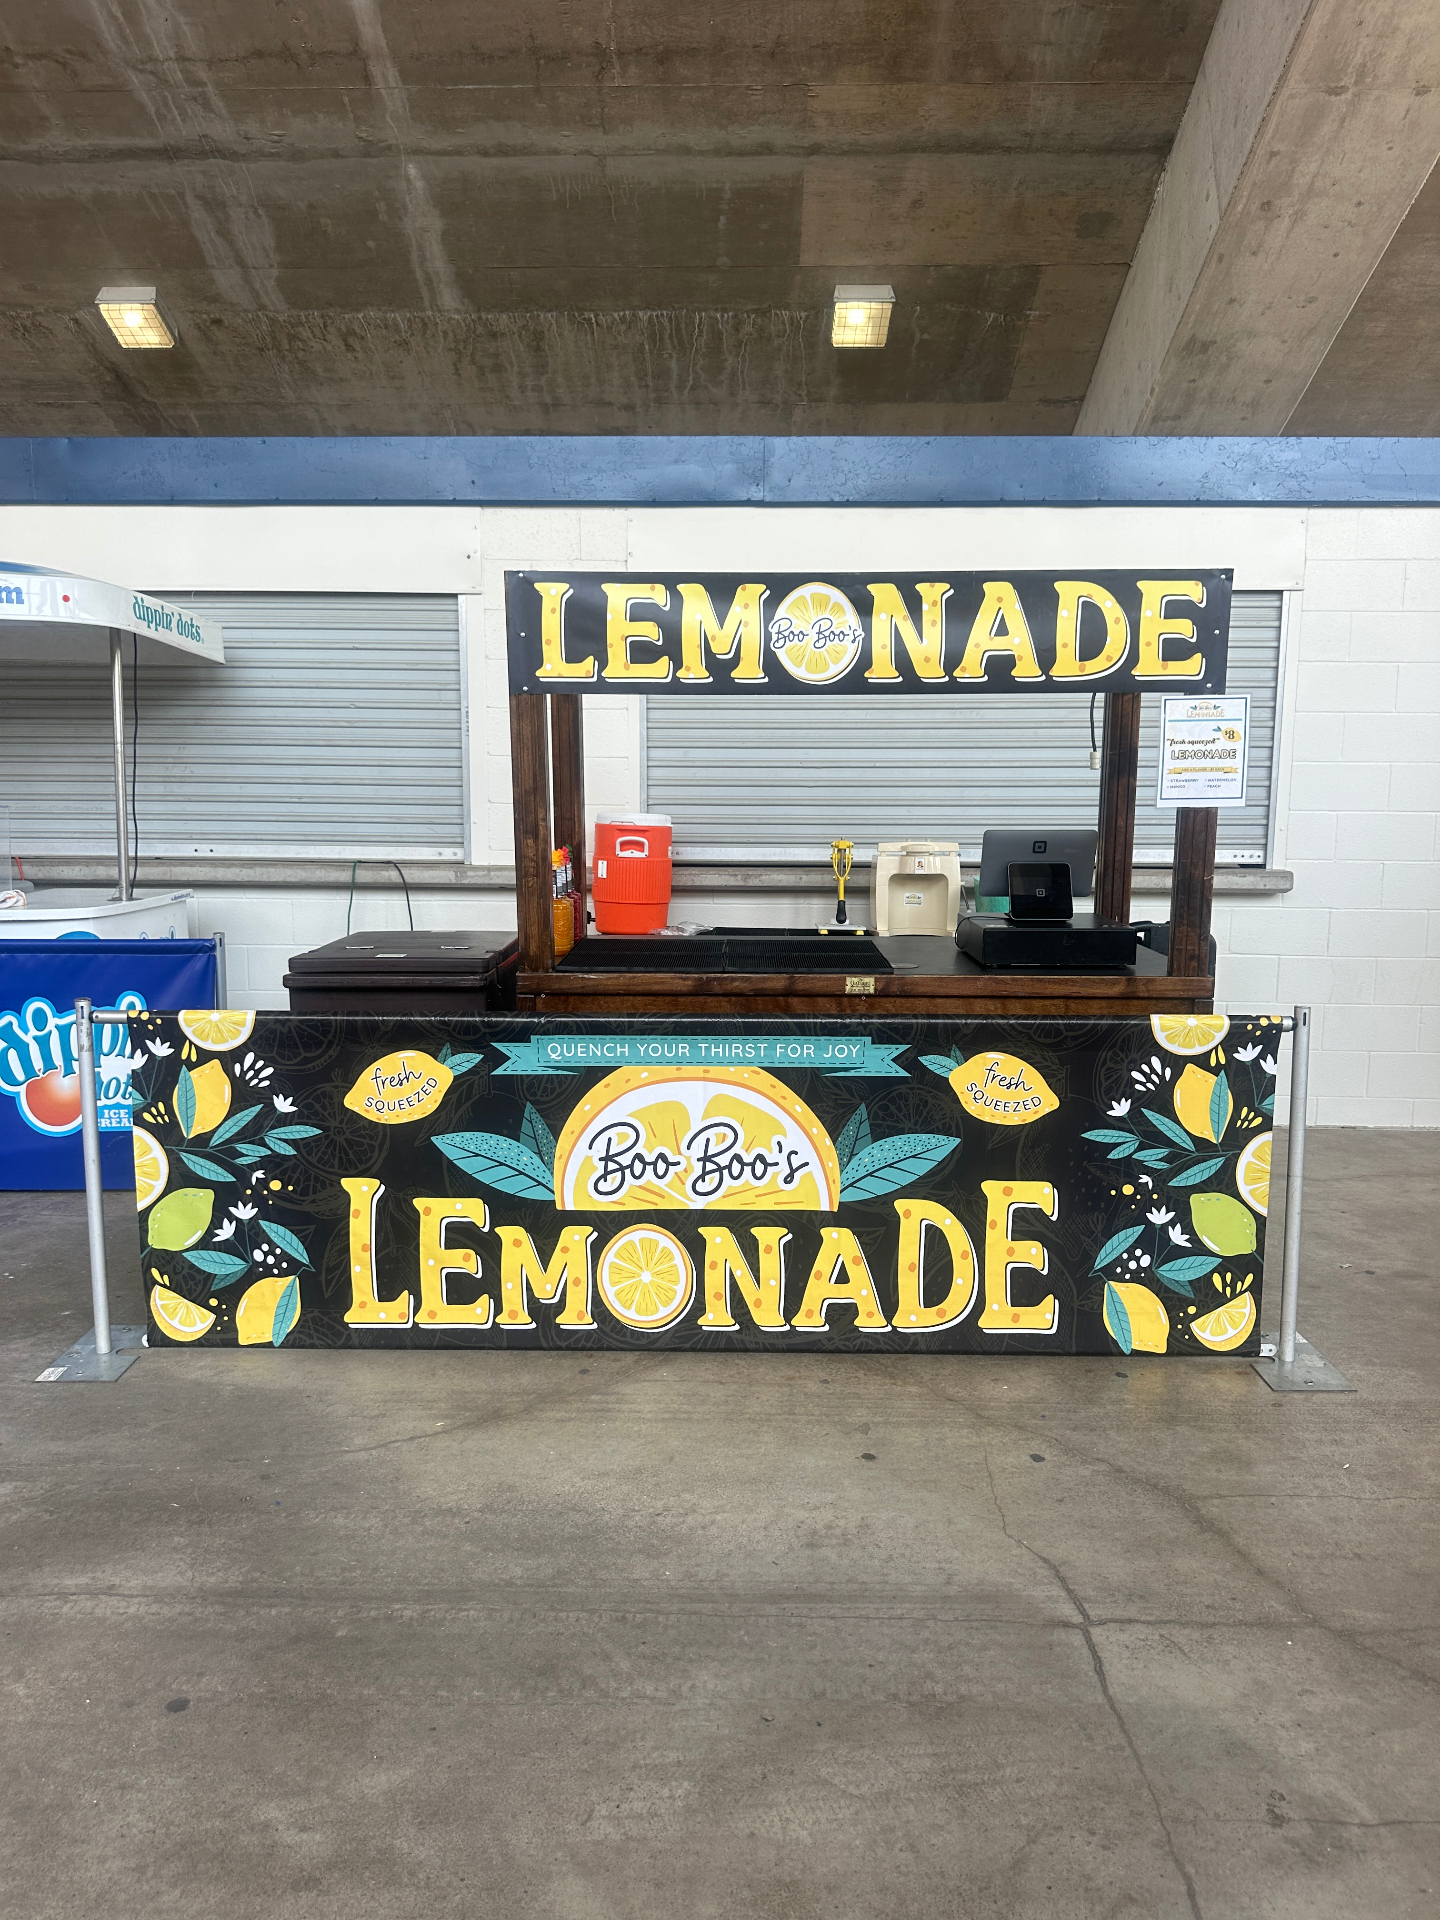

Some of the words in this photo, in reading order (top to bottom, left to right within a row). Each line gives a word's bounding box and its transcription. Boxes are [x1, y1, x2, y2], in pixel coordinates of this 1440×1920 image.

[132, 595, 175, 632] dippin'
[176, 612, 201, 643] dots
[533, 581, 1206, 684] LEMONADE
[770, 617, 809, 649] Boo
[811, 617, 862, 649] Boo's
[1224, 730, 1235, 740] $8
[1171, 749, 1237, 760] LEMONADE
[547, 1043, 629, 1060] QUENCH
[637, 1043, 690, 1057] YOUR
[698, 1043, 768, 1058] THIRST
[776, 1044, 815, 1058] FOR
[823, 1044, 861, 1058] JOY
[371, 1060, 423, 1097] fresh
[983, 1061, 1033, 1092] fresh
[364, 1077, 438, 1113] SQUEEZED
[966, 1082, 1042, 1113] SQUEEZED
[97, 1118, 133, 1127] REA
[103, 1109, 129, 1118] ICE
[588, 1121, 681, 1196] Boo
[687, 1121, 810, 1196] Boo's
[341, 1177, 1058, 1333] LEMONADE
